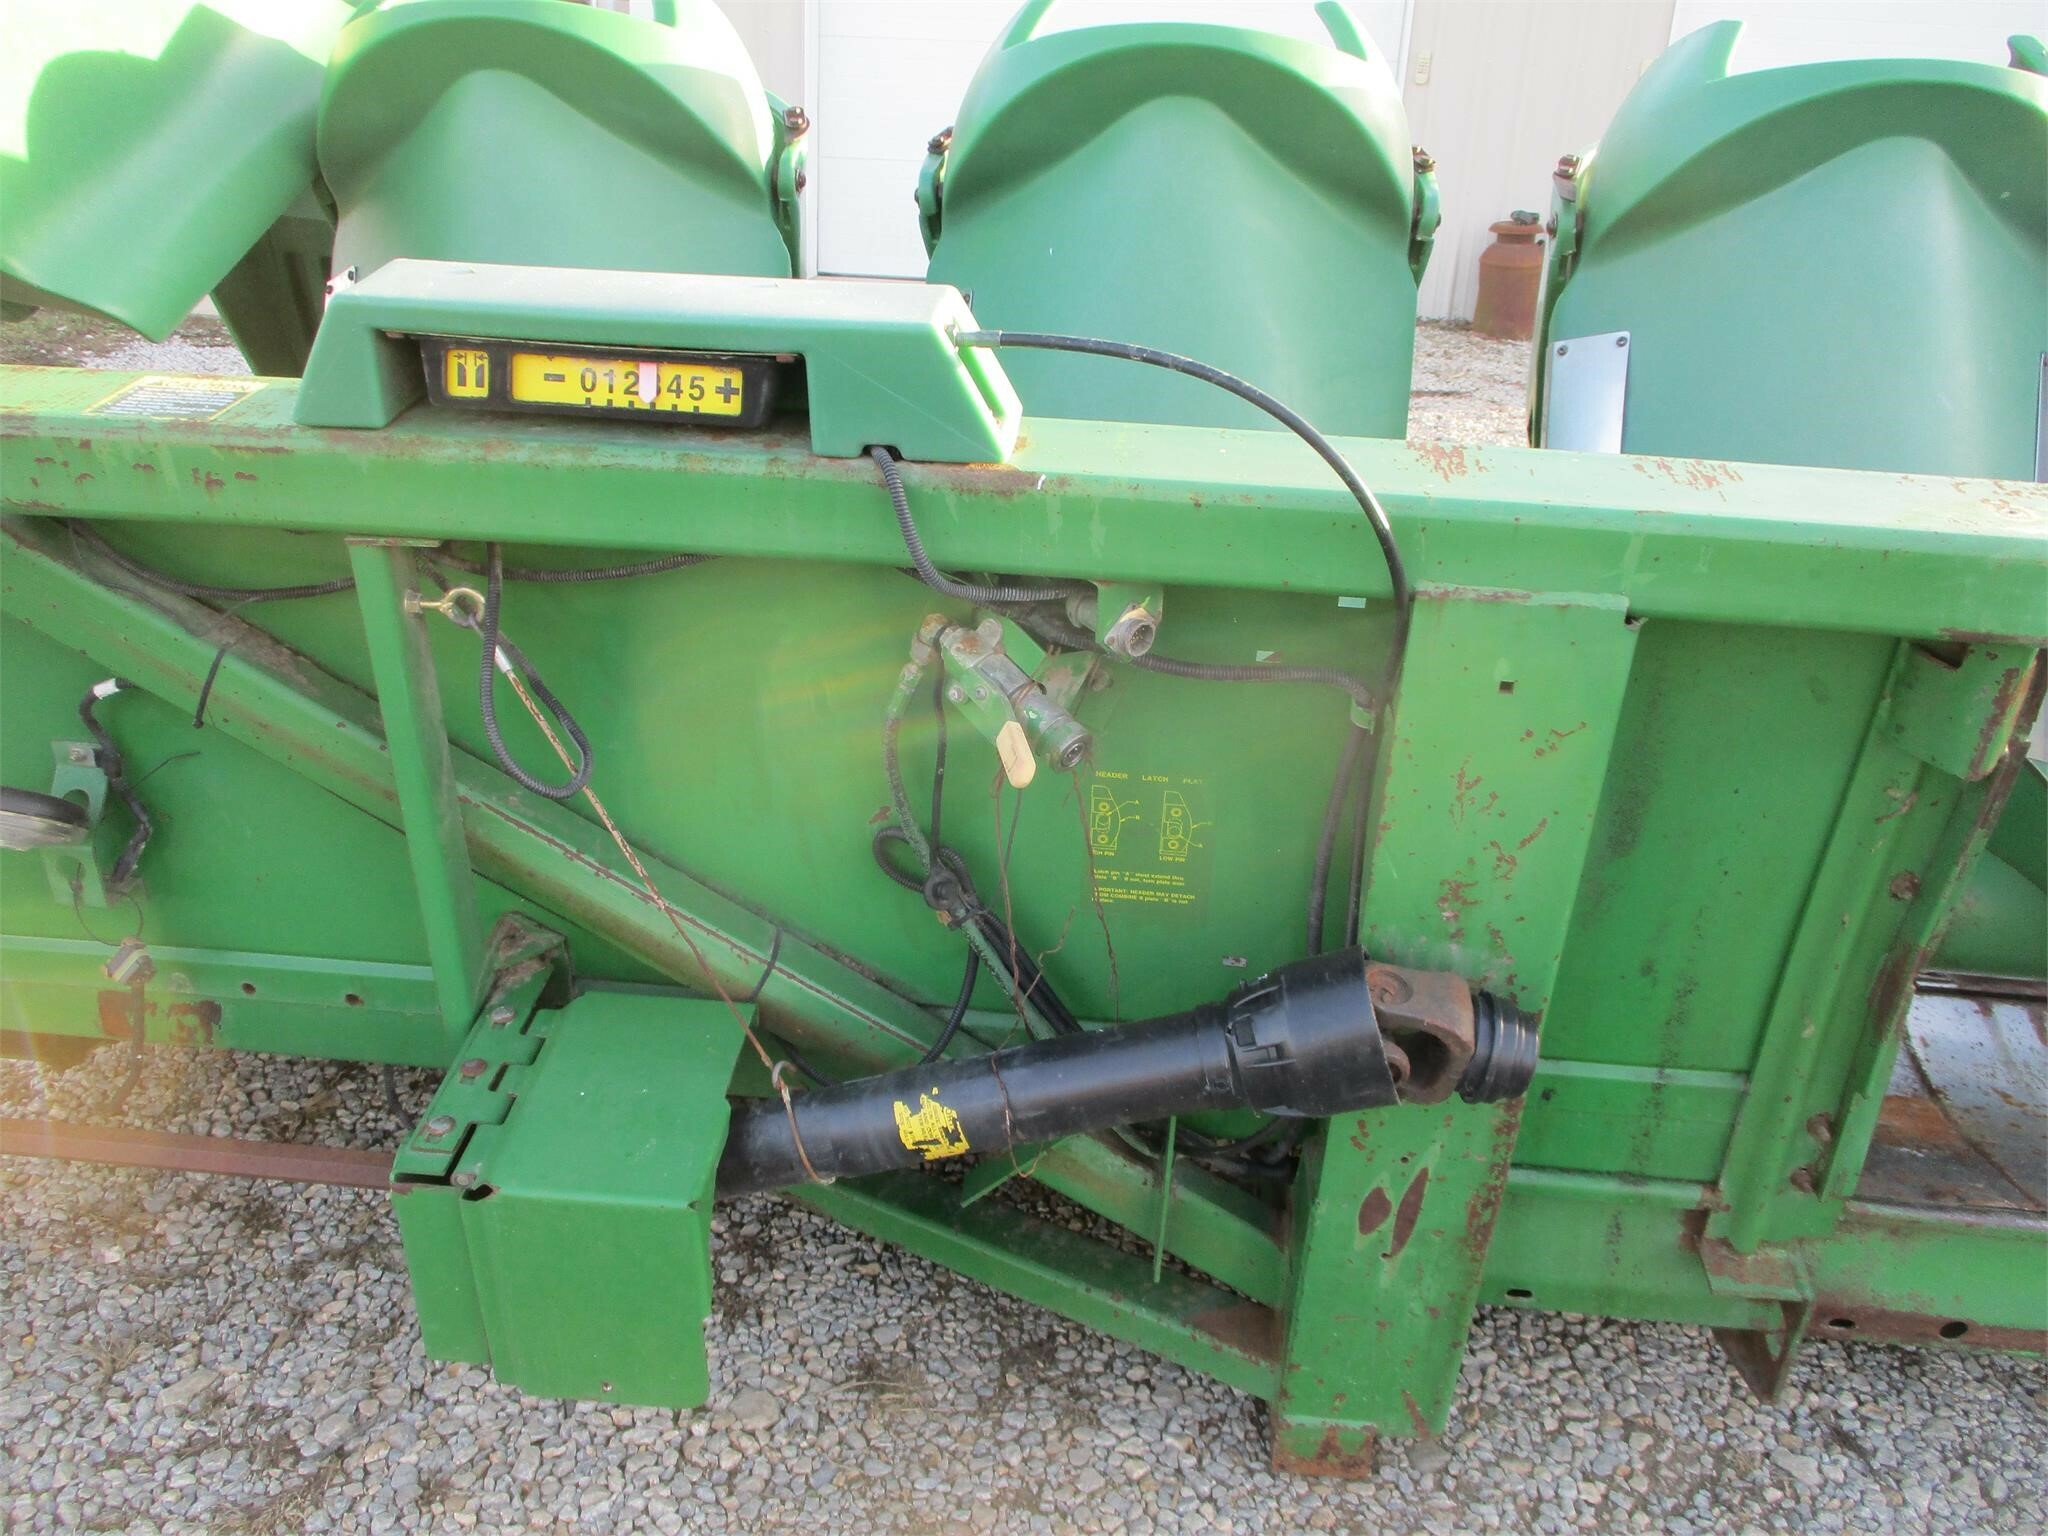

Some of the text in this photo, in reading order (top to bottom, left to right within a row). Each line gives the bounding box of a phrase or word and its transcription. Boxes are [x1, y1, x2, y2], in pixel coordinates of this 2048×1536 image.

[579, 366, 706, 401] 01245
[1096, 770, 1128, 780] HEADER
[1142, 775, 1169, 783] LATCH
